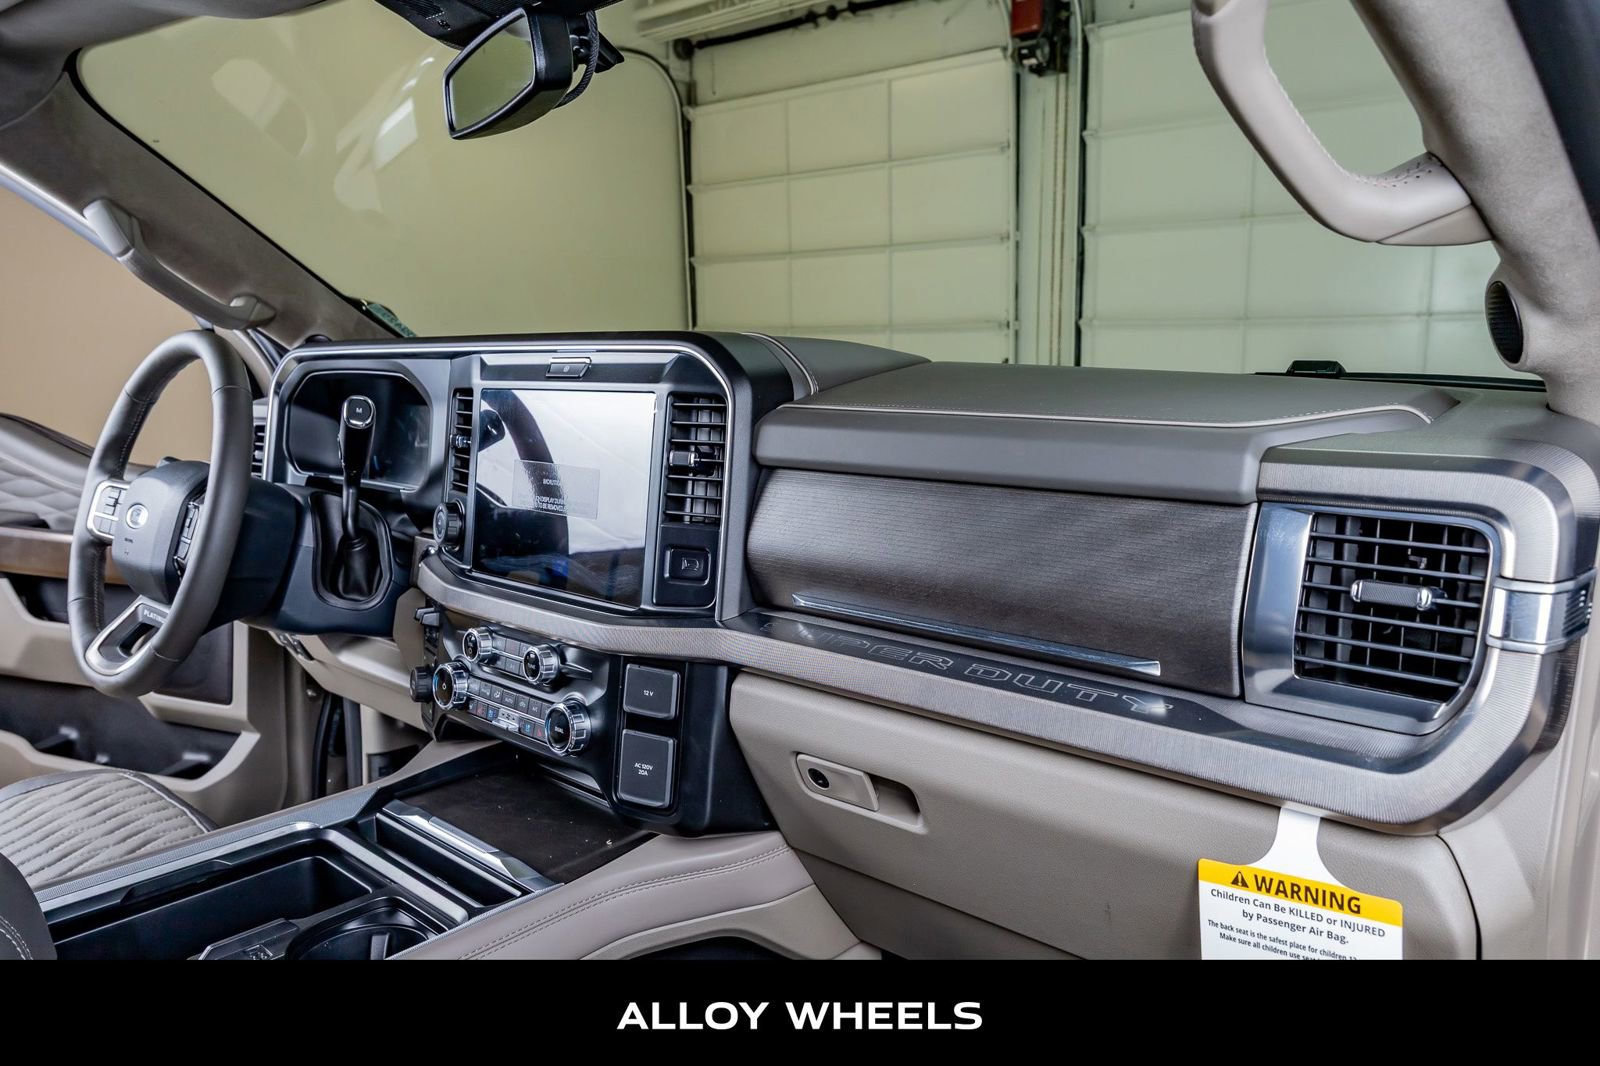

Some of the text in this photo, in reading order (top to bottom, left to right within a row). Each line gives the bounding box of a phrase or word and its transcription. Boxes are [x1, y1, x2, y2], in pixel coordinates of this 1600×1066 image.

[964, 663, 1174, 716] DUTY
[641, 763, 653, 771] 120V
[1210, 888, 1386, 938] Children Can Be KILLED or INJURED
[1254, 874, 1361, 915] WARNING
[1207, 919, 1219, 929] The
[1219, 922, 1235, 932] back
[1235, 927, 1249, 937] seat
[1249, 929, 1256, 938] is
[1256, 932, 1268, 941] the
[1268, 936, 1288, 947] safest
[1289, 940, 1307, 952] place
[1307, 944, 1318, 954] for
[1319, 948, 1347, 960] children
[1219, 932, 1237, 943] Make
[1237, 938, 1252, 947] sure
[1252, 941, 1261, 950] all
[1261, 944, 1288, 957] children
[1288, 951, 1301, 960] use
[1242, 909, 1349, 945] by Passenger Air Bag.
